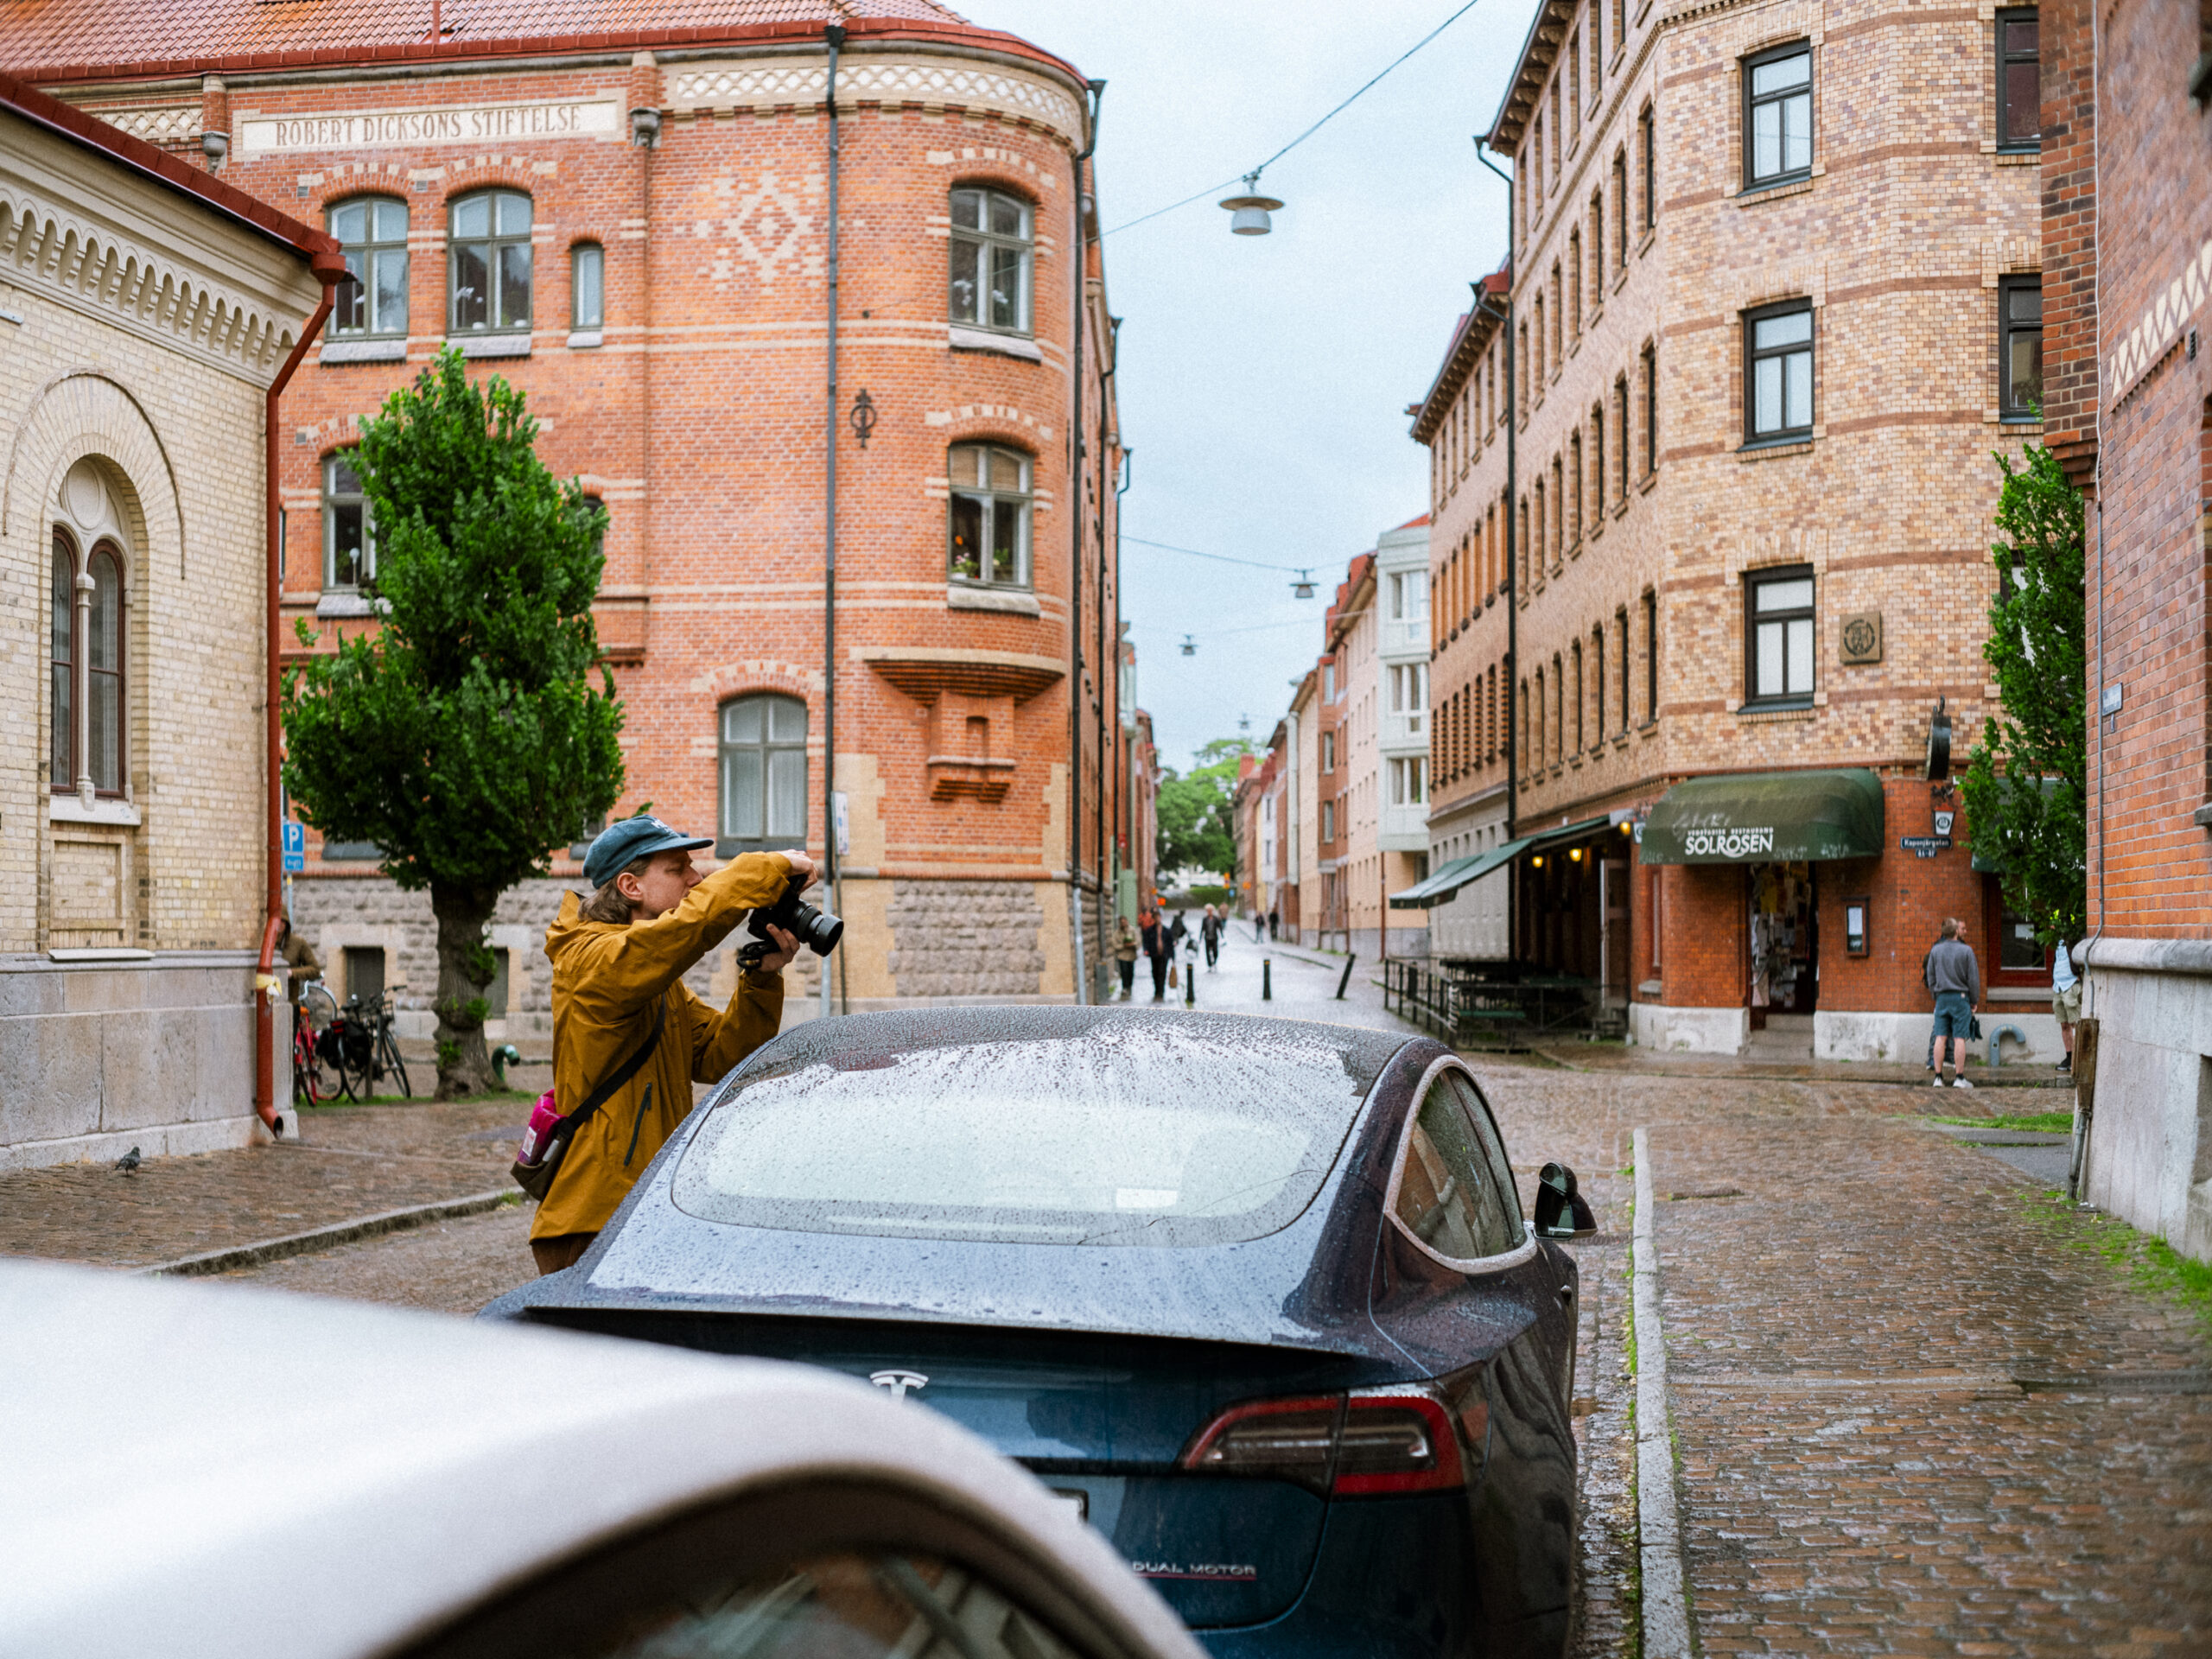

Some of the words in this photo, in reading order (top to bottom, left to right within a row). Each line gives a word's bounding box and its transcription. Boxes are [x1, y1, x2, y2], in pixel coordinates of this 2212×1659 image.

[276, 118, 354, 146] ROBERT
[363, 112, 461, 143] DICKSONS
[472, 105, 581, 137] STIFTELSE
[289, 825, 300, 851] P
[1685, 834, 1774, 858] SOLROSEN
[1133, 1560, 1184, 1573] DUAL
[1189, 1564, 1256, 1575] MOTOR
